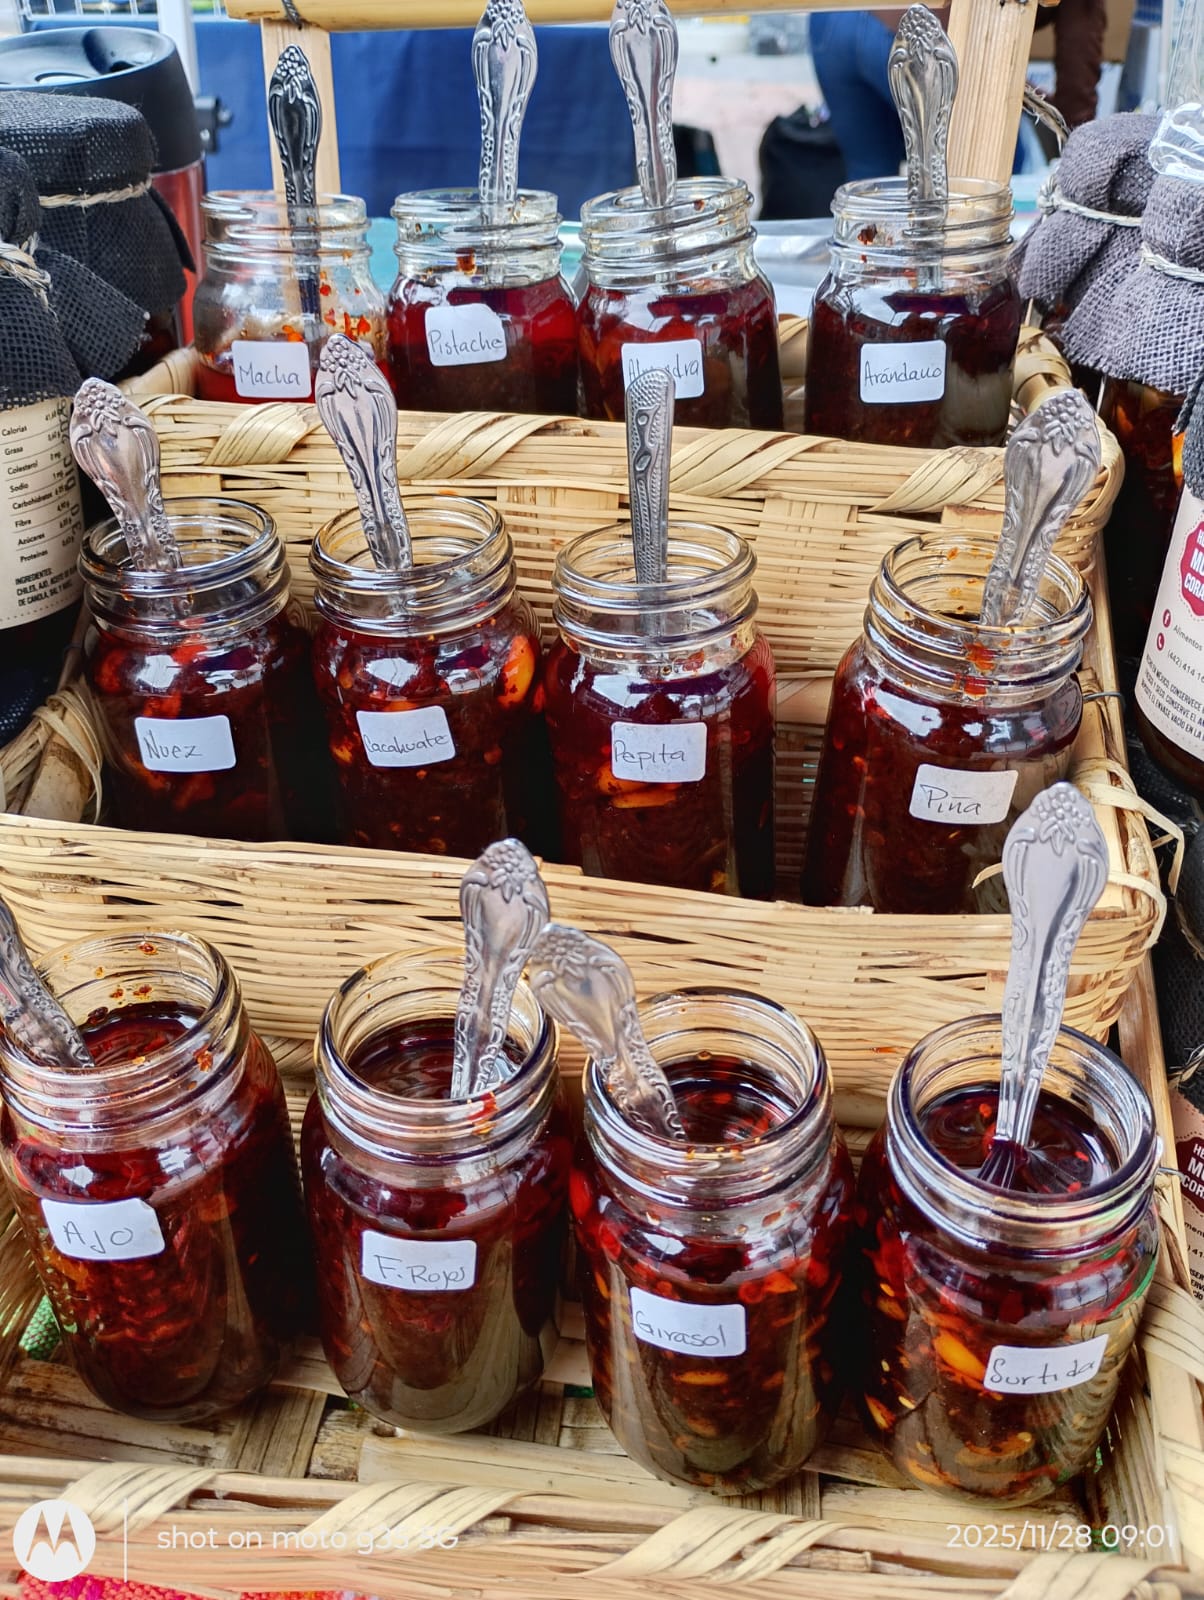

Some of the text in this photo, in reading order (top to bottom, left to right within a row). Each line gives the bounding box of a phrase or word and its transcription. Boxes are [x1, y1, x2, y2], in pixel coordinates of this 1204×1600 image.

[428, 329, 503, 355] Pistache
[239, 361, 301, 386] Macha
[143, 729, 203, 759] Nuez
[613, 739, 685, 770] Pepita
[919, 783, 982, 815] Piña
[635, 1310, 726, 1347] Girasol
